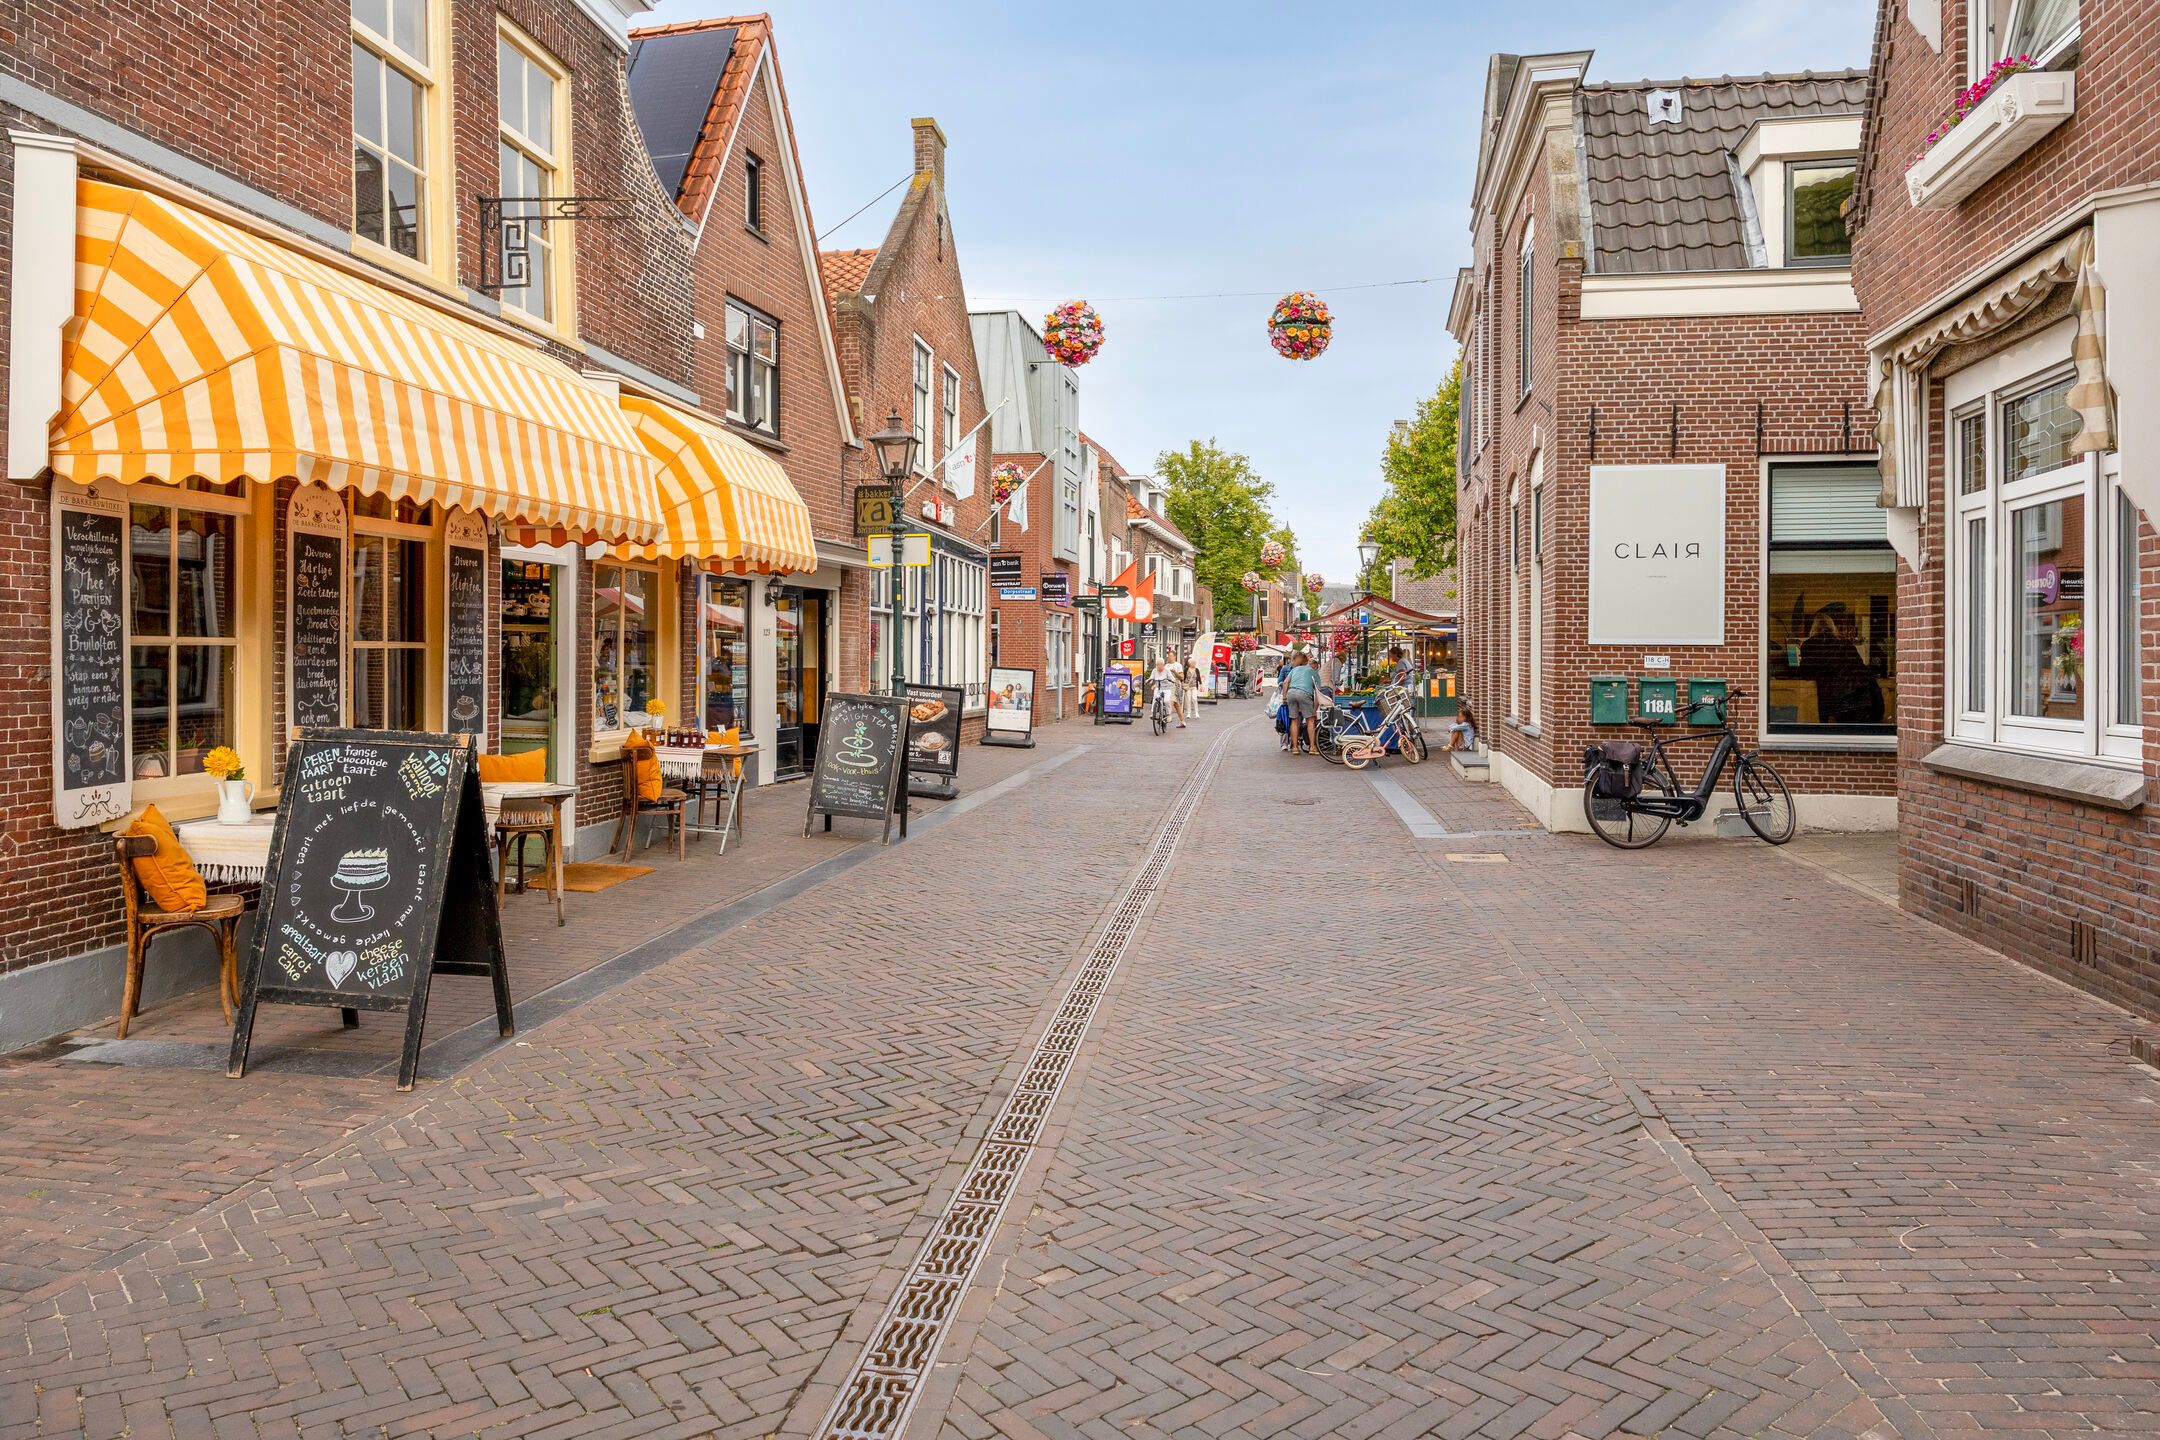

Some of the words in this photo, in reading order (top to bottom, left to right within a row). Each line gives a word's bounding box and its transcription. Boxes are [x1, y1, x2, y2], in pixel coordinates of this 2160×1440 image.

[60, 495, 69, 503] DE
[864, 489, 892, 498] bakker
[76, 567, 105, 591] Thee
[299, 559, 333, 581] Hartige
[68, 634, 118, 660] Bruiloften
[296, 631, 338, 645] traditioneel
[91, 672, 109, 680] eens
[73, 684, 101, 694] binnen
[906, 689, 919, 697] Vast
[919, 691, 943, 699] voordeel
[67, 695, 90, 711] vraag
[1643, 699, 1674, 713] 118A
[880, 707, 895, 722] OLD
[886, 723, 898, 756] BAKERY
[303, 747, 340, 770] PEREN
[344, 744, 378, 758] franse
[301, 761, 334, 780] TAART
[343, 764, 377, 777] taart
[424, 749, 447, 777] TIP
[301, 775, 351, 793] citroen
[407, 752, 442, 799] walnoot
[307, 787, 347, 803] taart
[340, 798, 377, 815] liefde
[314, 813, 334, 834] met
[384, 805, 427, 853] gemaakt
[296, 836, 313, 865] taart
[414, 863, 427, 902] taart
[394, 905, 414, 928] met
[355, 929, 391, 947] liefde
[281, 943, 314, 974] carrot
[360, 939, 403, 961] cheese
[369, 949, 399, 966] cake
[356, 953, 410, 982] kersen
